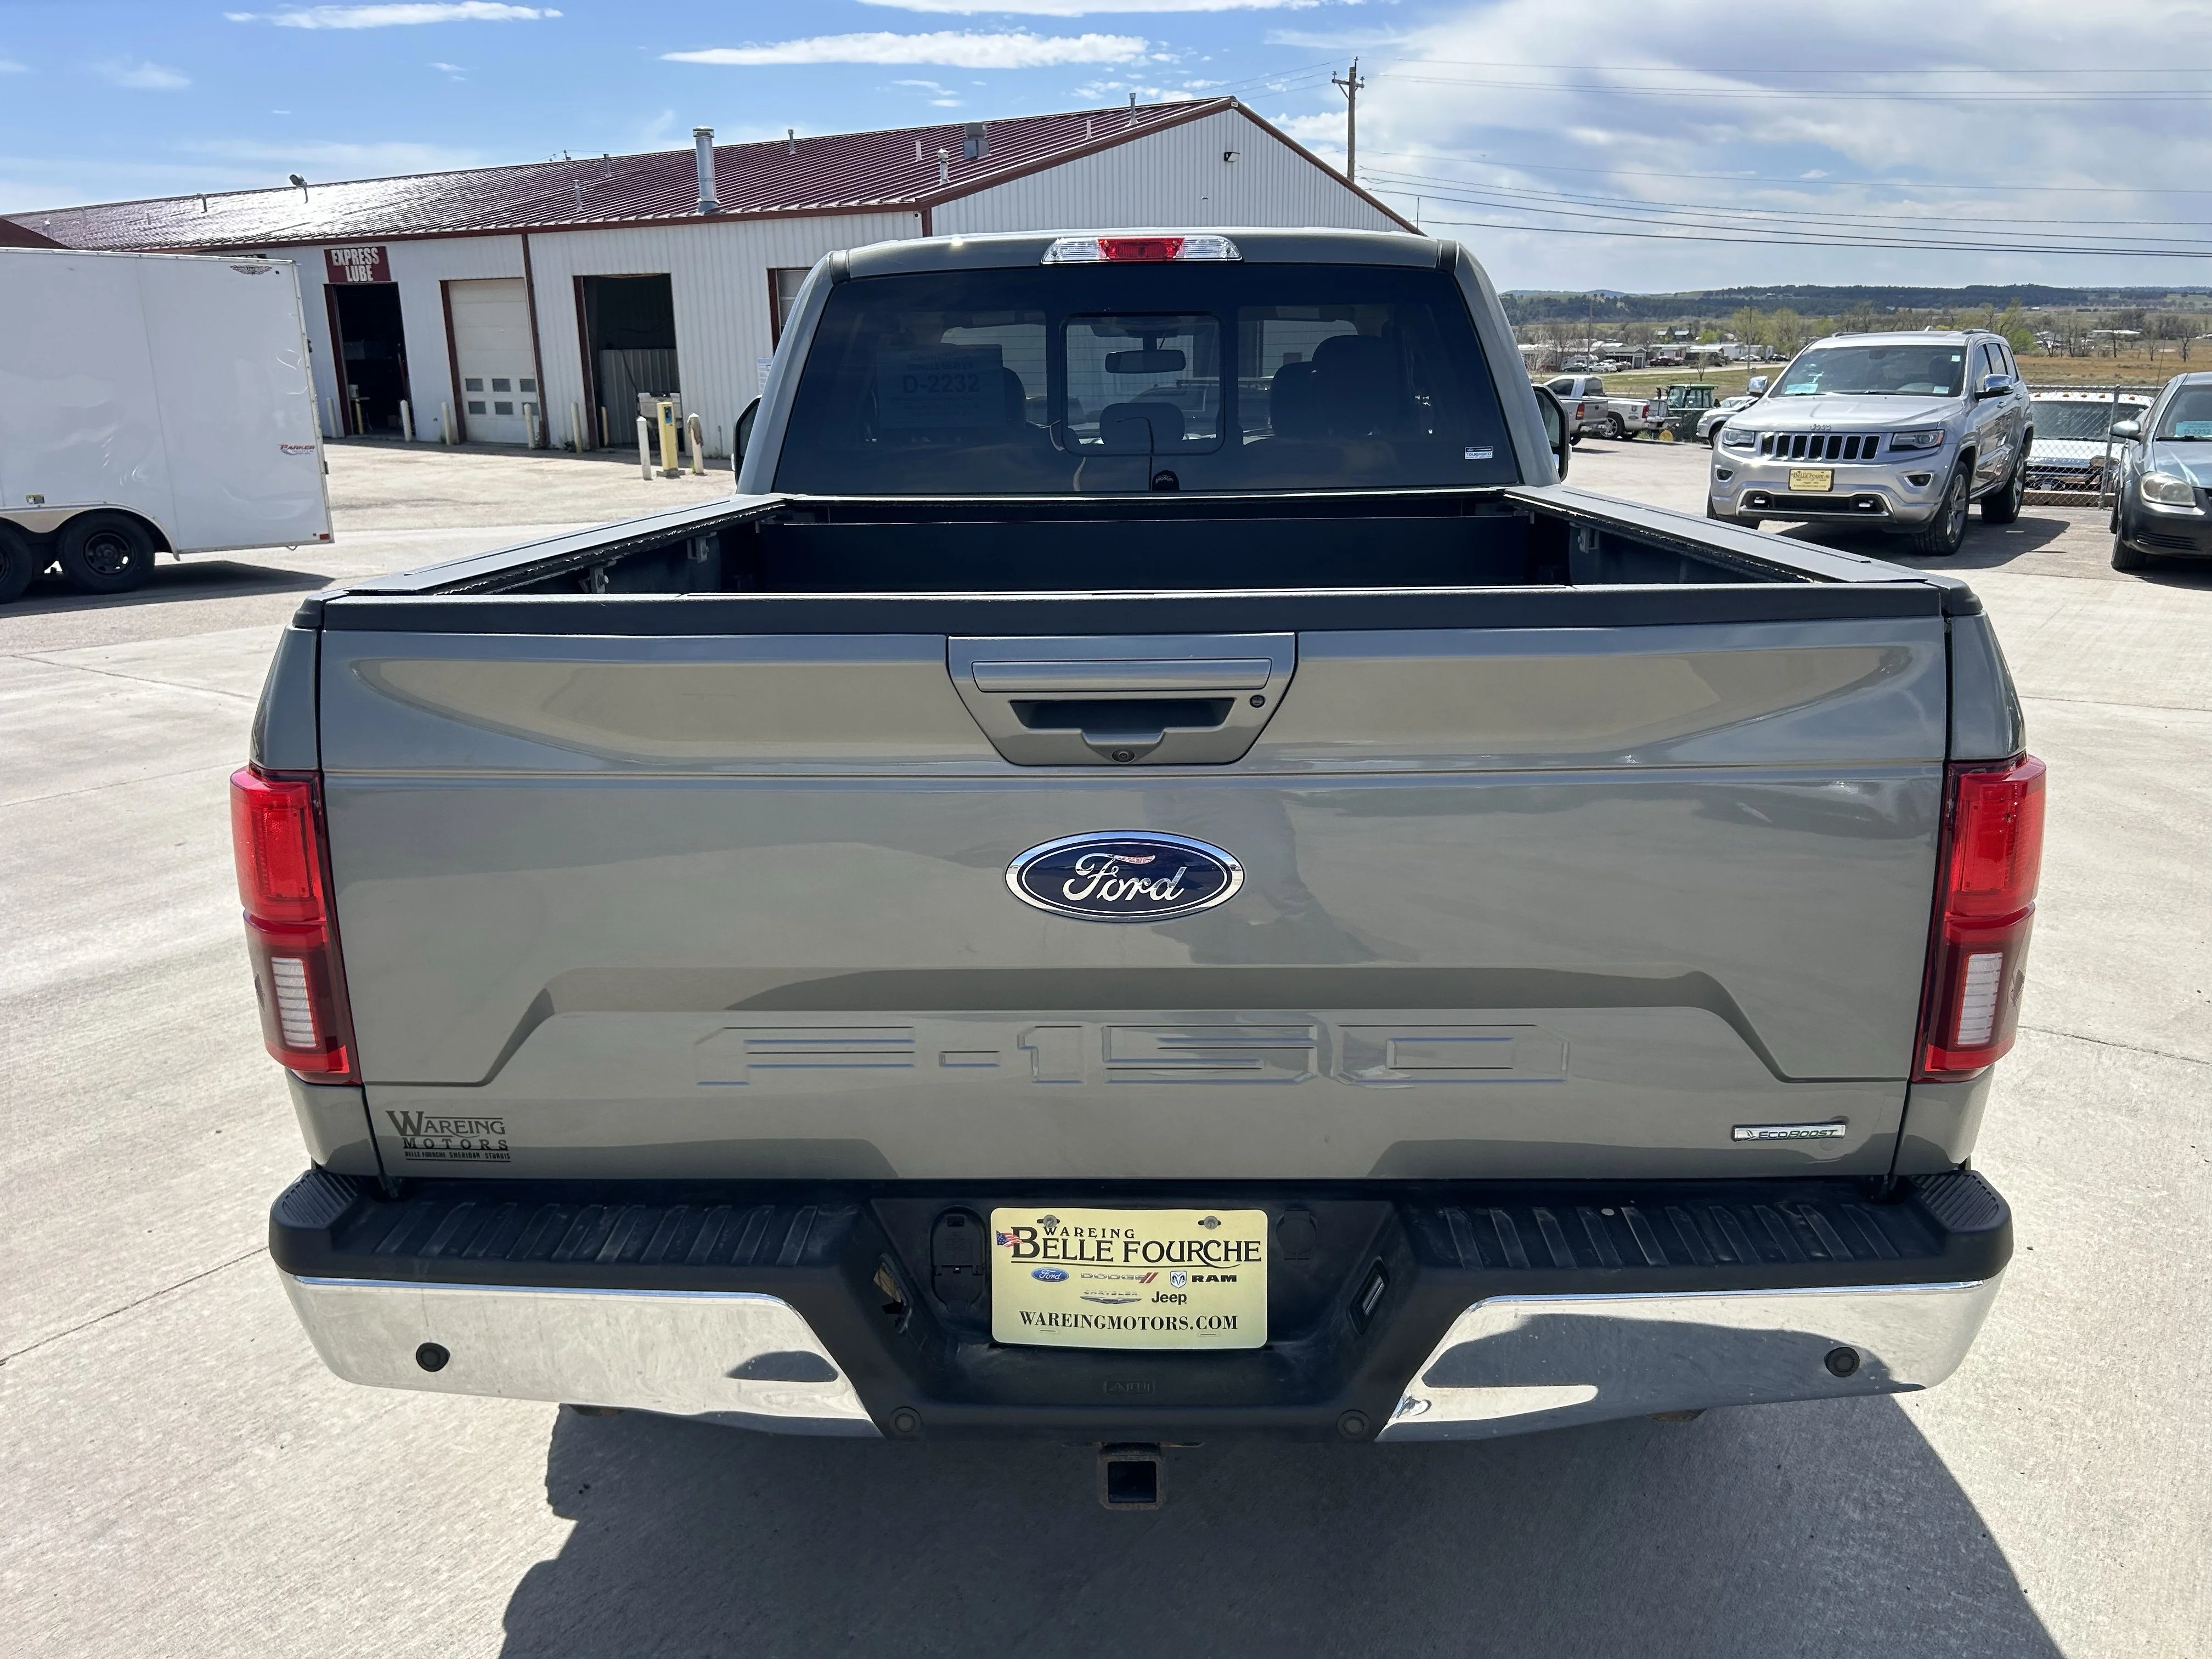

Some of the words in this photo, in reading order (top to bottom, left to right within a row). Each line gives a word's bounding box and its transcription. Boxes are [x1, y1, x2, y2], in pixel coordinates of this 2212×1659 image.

[331, 247, 380, 266] EXPRESS
[345, 265, 374, 282] LUBE
[903, 374, 980, 394] D-2232
[1063, 853, 1187, 901] Ford
[694, 1025, 1569, 1085] F-150
[385, 1110, 506, 1137] WAREING
[402, 1137, 510, 1150] MOTORS
[1043, 1226, 1135, 1239] WAREING
[1011, 1226, 1114, 1262] BELLE
[1123, 1240, 1262, 1266] FOURCHE
[1039, 1269, 1062, 1280] Ford
[1080, 1272, 1146, 1280] DODGE
[1192, 1274, 1237, 1283] RAM
[1151, 1291, 1187, 1305] Jeep
[1019, 1311, 1238, 1330] WAREINGMOTORS.COM
